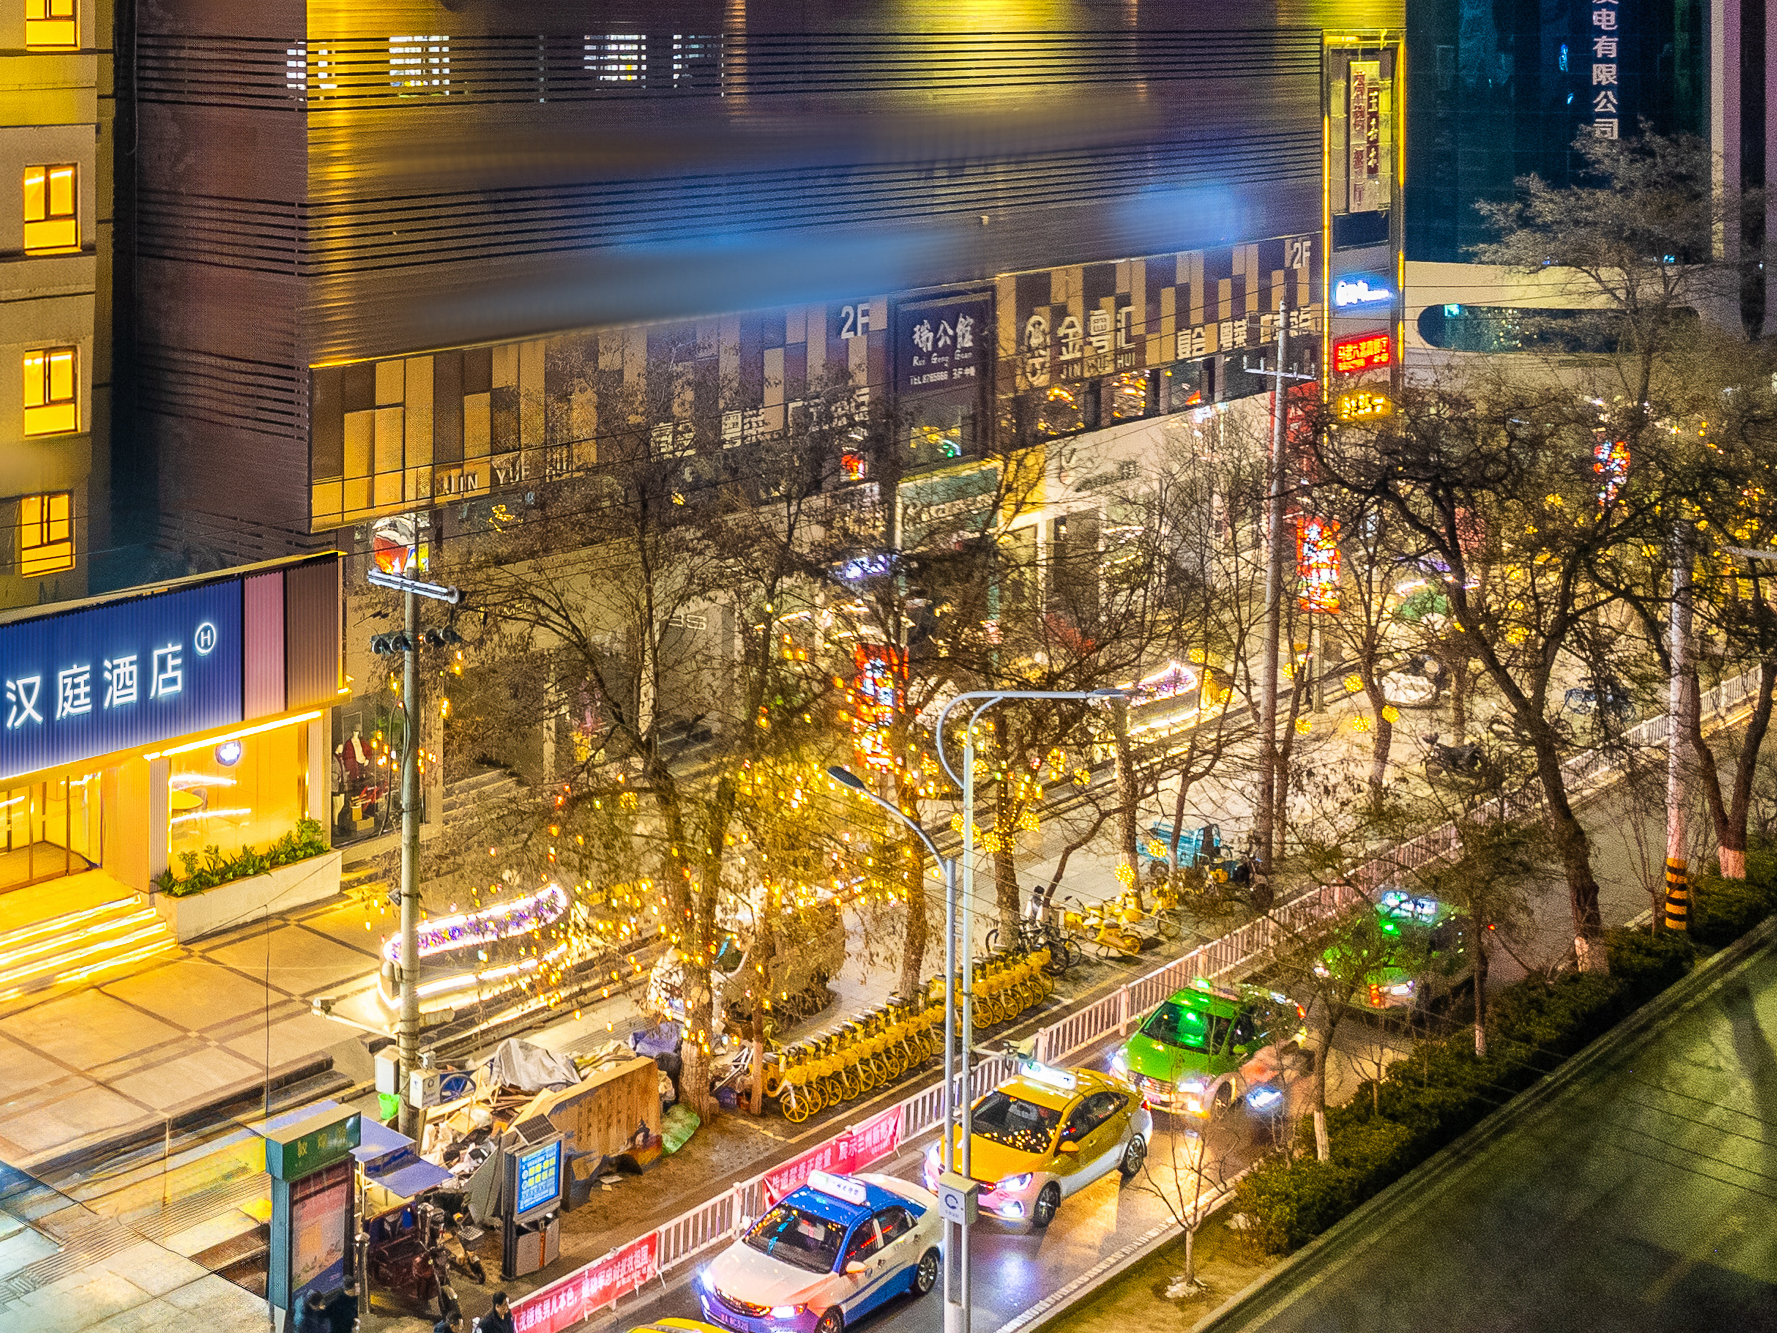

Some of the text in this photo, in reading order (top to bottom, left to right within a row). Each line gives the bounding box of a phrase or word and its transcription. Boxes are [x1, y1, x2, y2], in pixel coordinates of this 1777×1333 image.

[1292, 241, 1311, 269] 2F
[841, 304, 870, 339] 2F
[1057, 305, 1136, 361] 金粤汇
[1177, 328, 1206, 360] 宴会
[1220, 319, 1247, 352] 粤菜
[6, 643, 183, 729] 汉庭酒店
